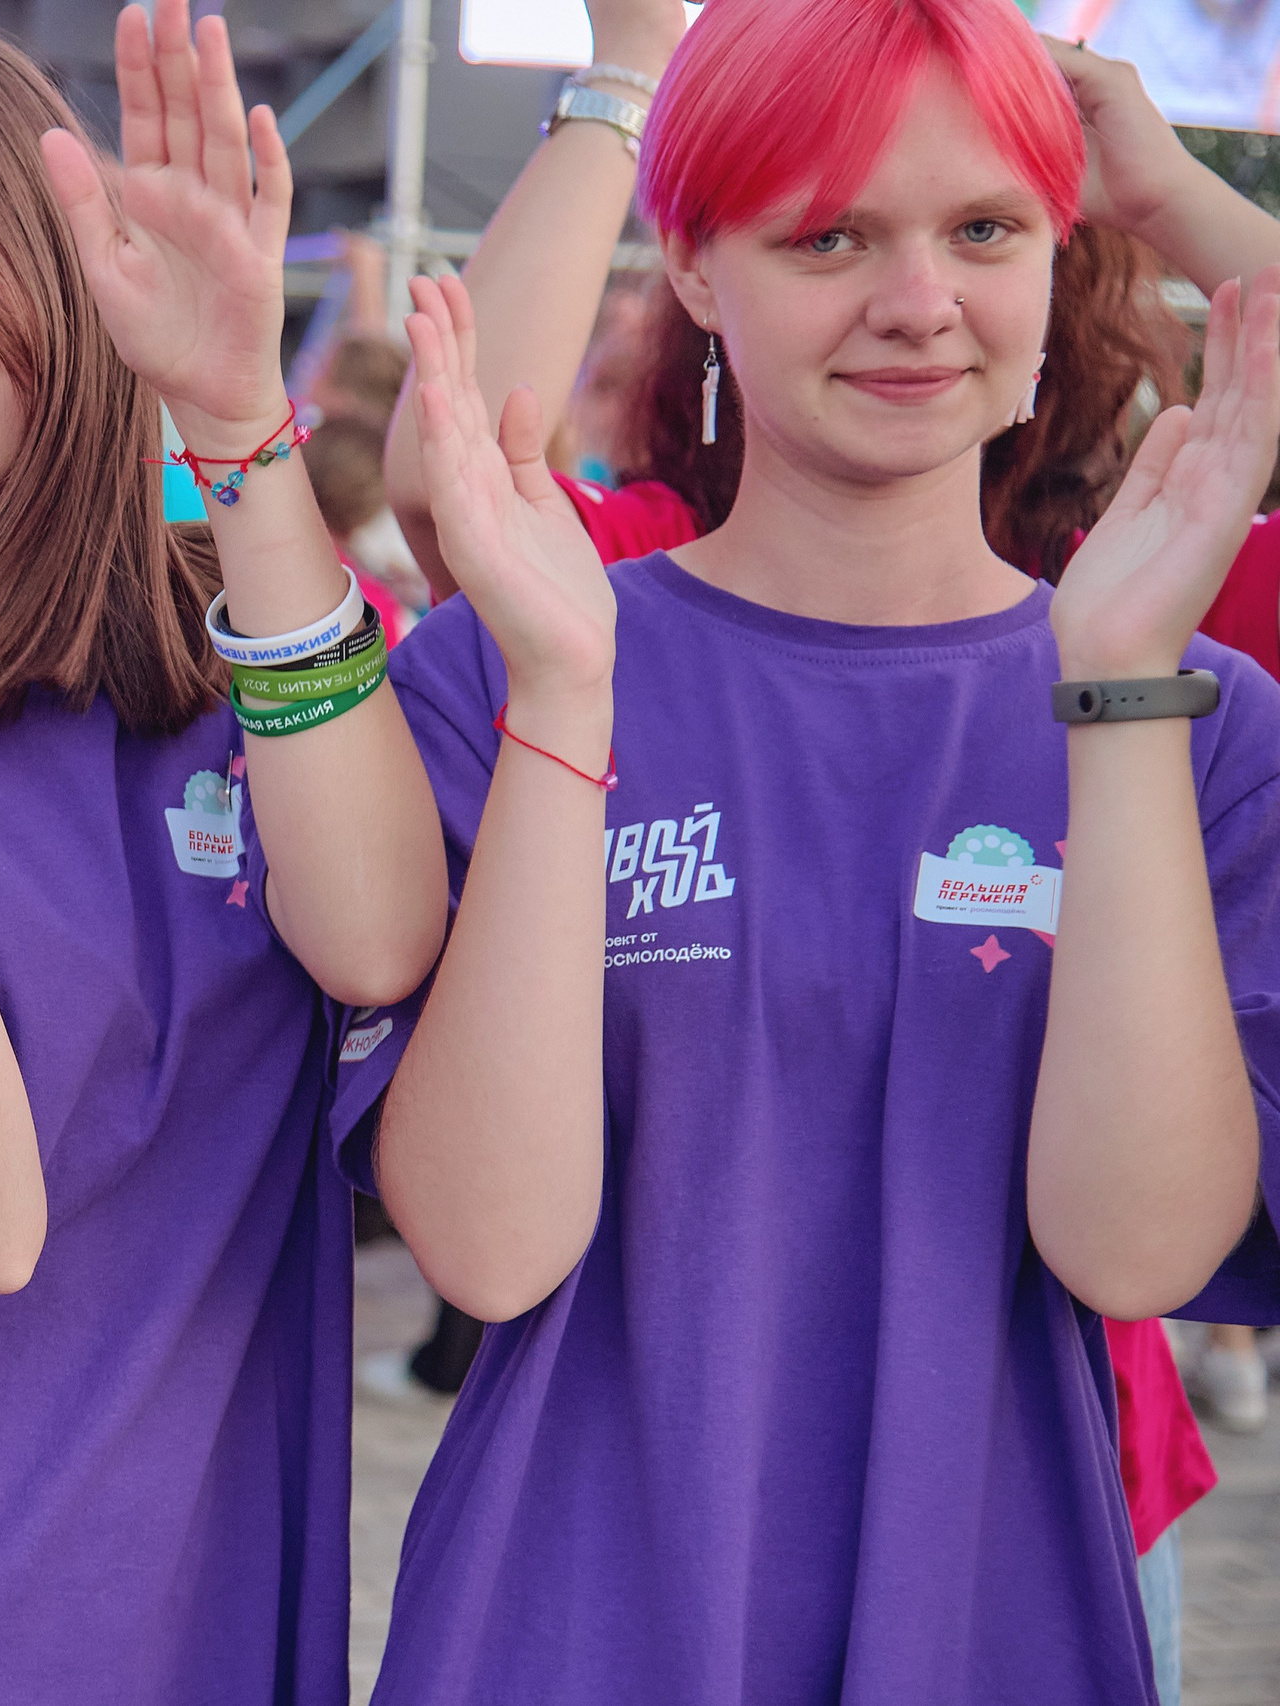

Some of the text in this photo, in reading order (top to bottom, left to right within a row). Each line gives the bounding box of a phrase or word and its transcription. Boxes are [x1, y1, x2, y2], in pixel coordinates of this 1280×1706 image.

[251, 622, 342, 661] ДВИЖЕНИЕ
[278, 674, 352, 694] РЕАКЦИЯ
[266, 700, 335, 731] РЕАКЦИЯ
[188, 830, 233, 844] БОЛЬШ
[189, 841, 234, 854] ПЕРЕМЕ
[941, 879, 1028, 894] БОЛЬШАЯ
[937, 889, 1025, 904] ПЕРЕМЕНА
[605, 932, 658, 947] оект от
[604, 943, 731, 968] осмолодёжь
